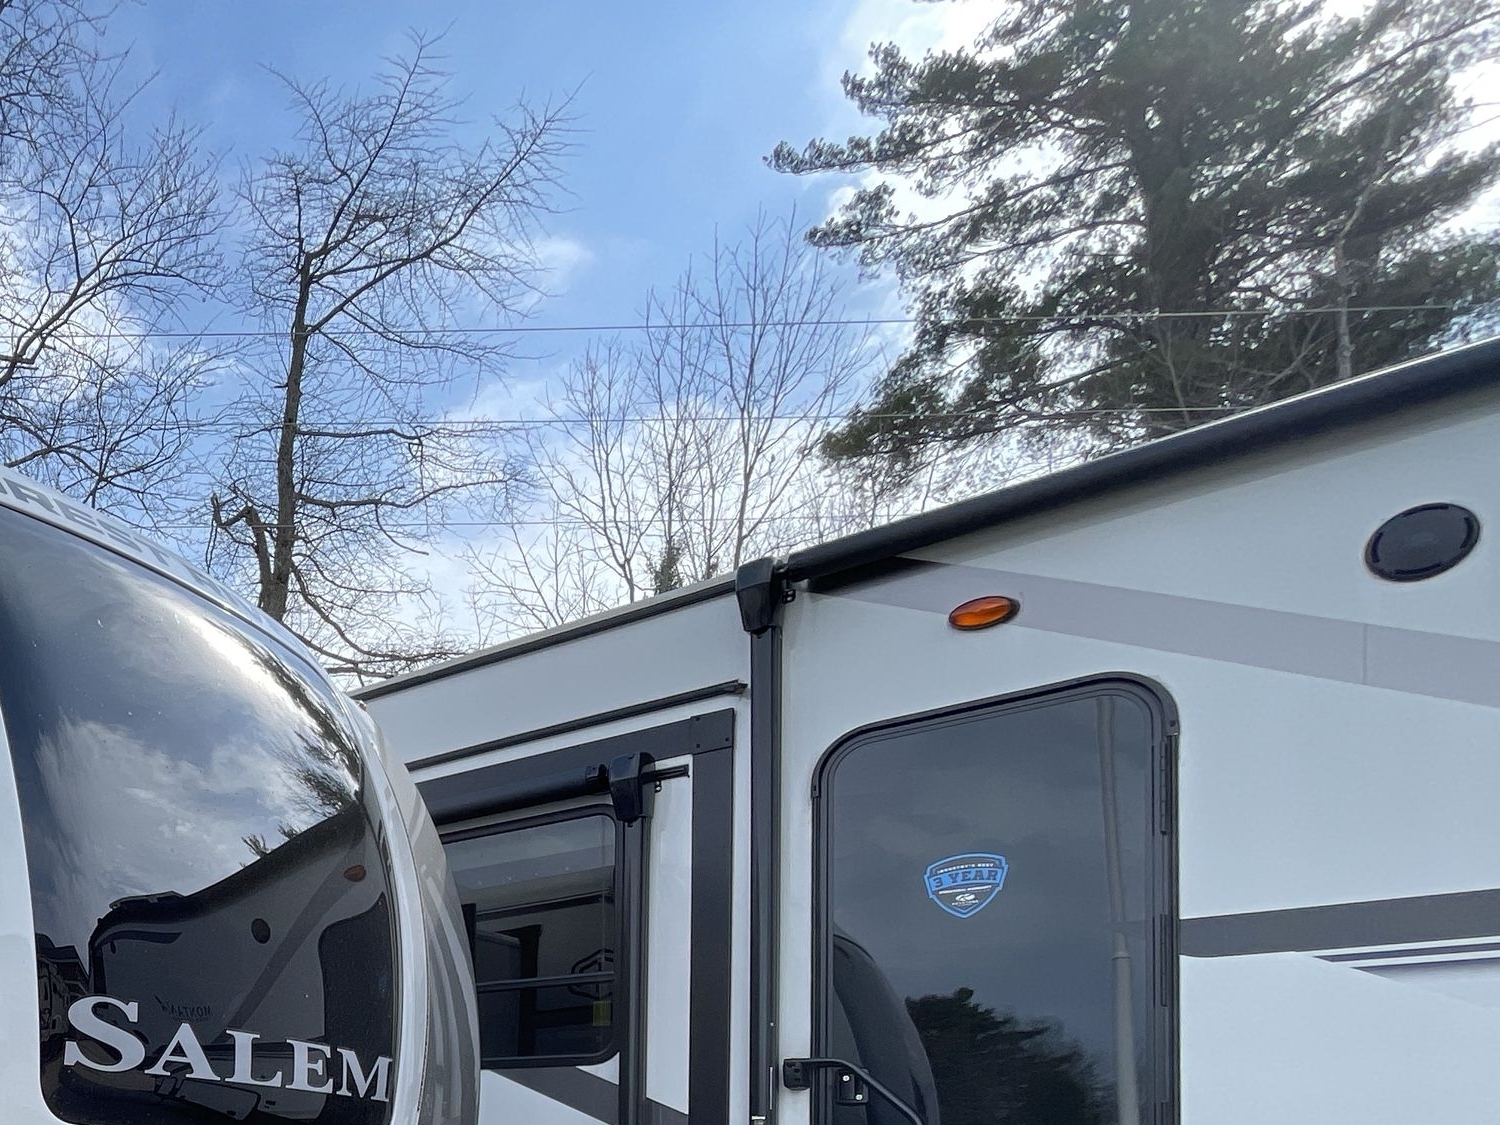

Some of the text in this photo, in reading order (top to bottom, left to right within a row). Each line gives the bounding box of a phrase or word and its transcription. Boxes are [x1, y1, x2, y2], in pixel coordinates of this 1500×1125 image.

[933, 877, 943, 888] 3
[948, 869, 997, 884] YEAR
[63, 995, 393, 1103] SALEM
